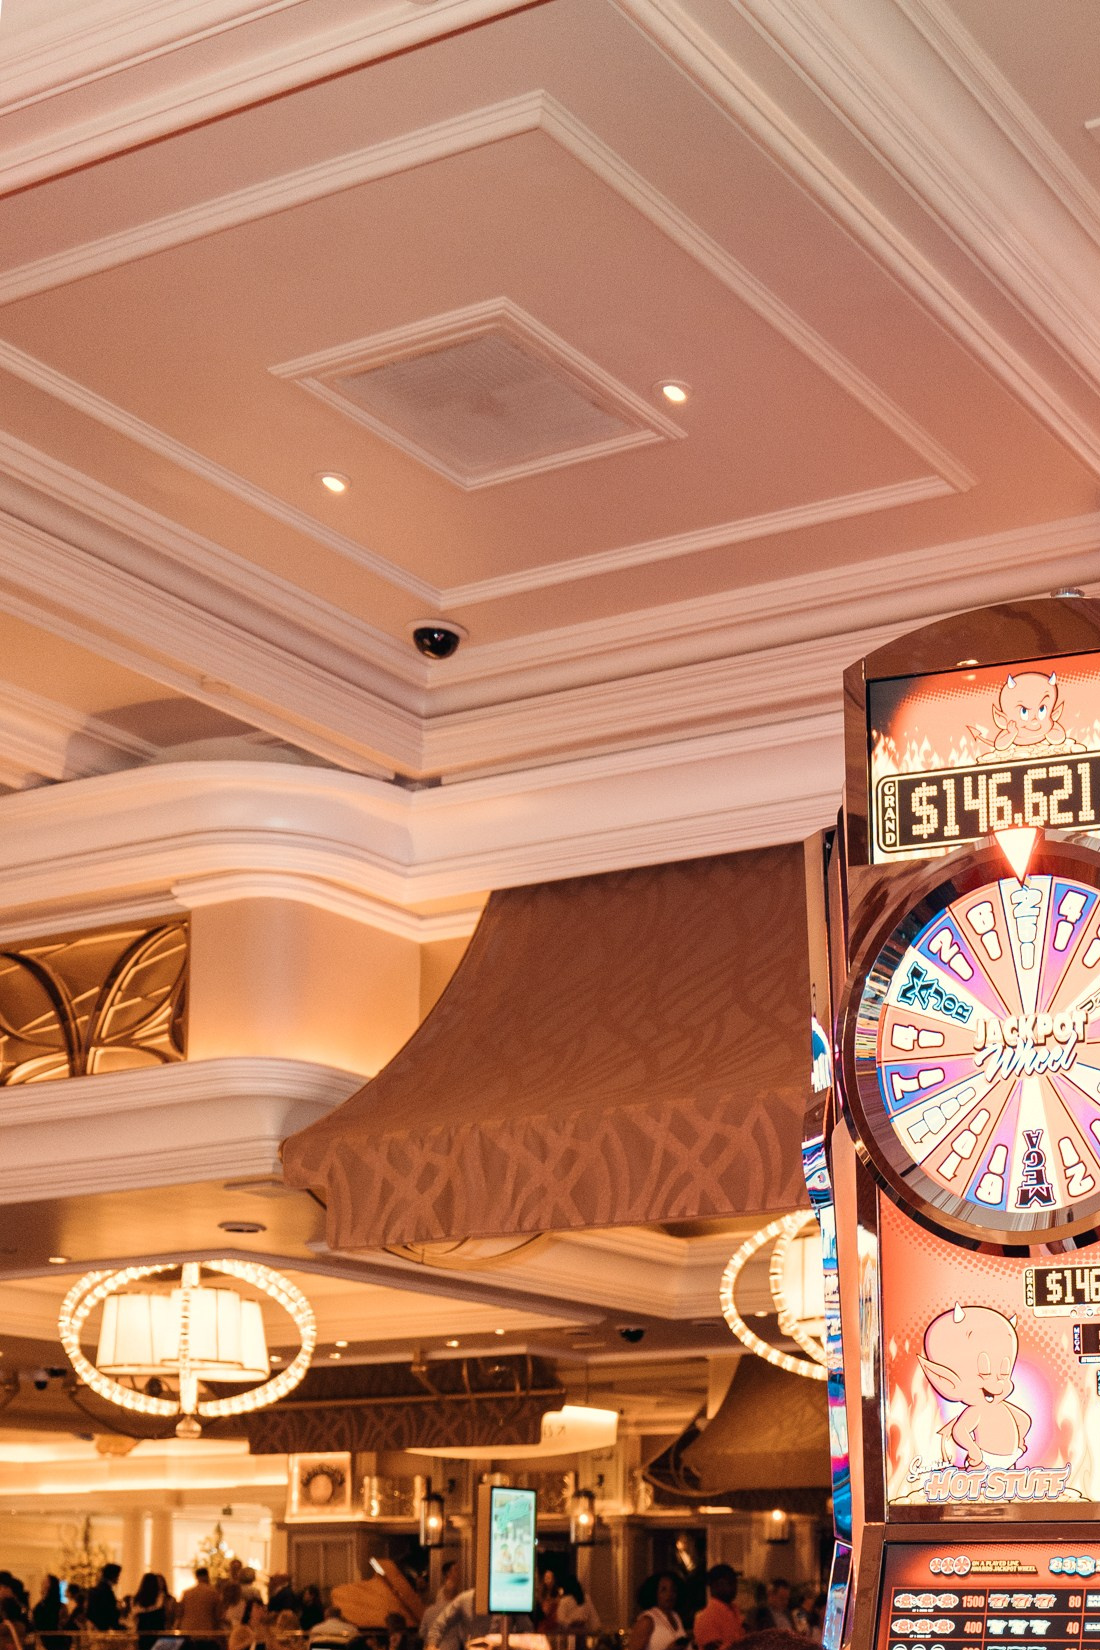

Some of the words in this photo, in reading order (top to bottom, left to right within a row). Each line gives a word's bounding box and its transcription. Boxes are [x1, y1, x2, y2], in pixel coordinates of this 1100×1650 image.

[883, 782, 896, 845] GRAND
[897, 961, 973, 1023] MAJOR
[973, 1011, 1088, 1051] JACKPOT
[974, 1032, 1077, 1083] Wheel
[1015, 1129, 1056, 1208] MEGA
[925, 1466, 989, 1502] HOT
[985, 1463, 1071, 1501] STUFF
[962, 1595, 985, 1608] 1500
[1068, 1595, 1082, 1608] 80
[964, 1621, 982, 1634] 400
[1066, 1622, 1080, 1634] 40
